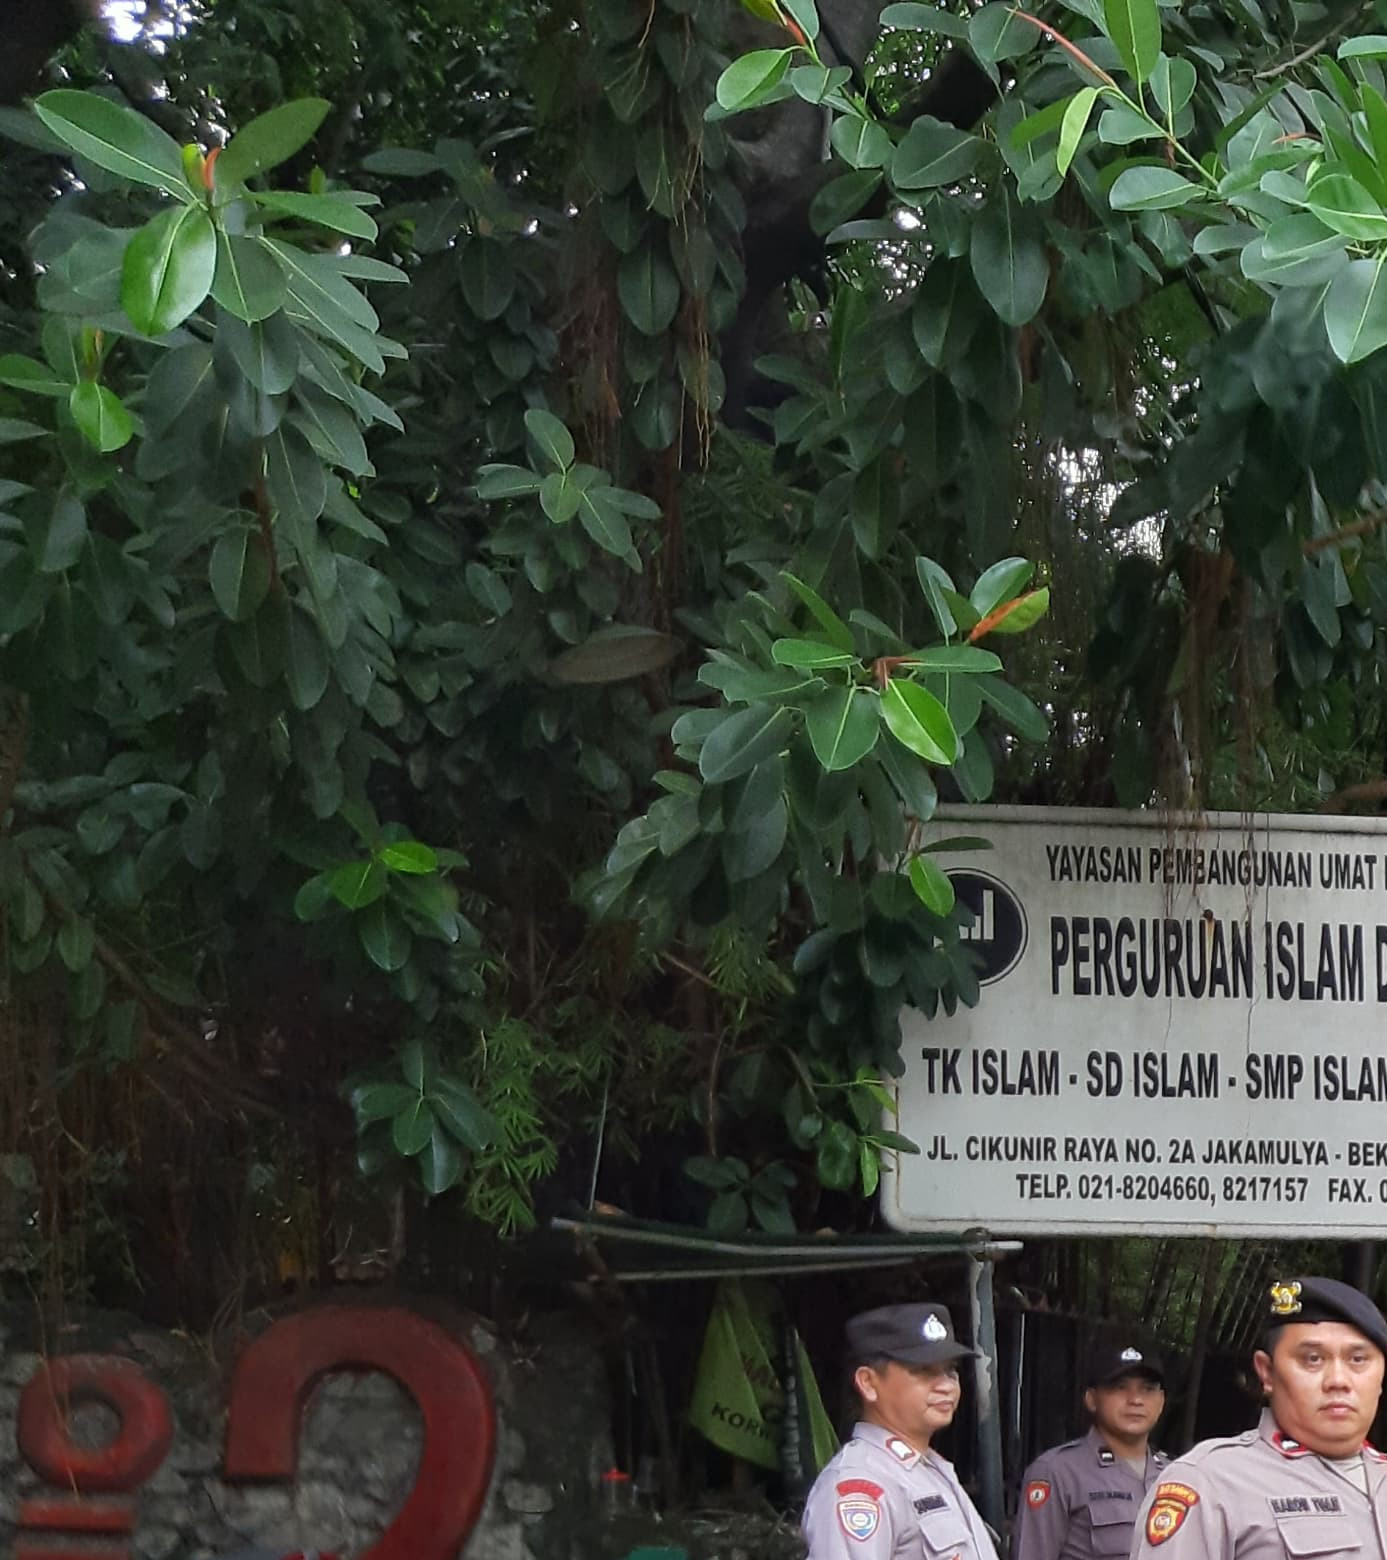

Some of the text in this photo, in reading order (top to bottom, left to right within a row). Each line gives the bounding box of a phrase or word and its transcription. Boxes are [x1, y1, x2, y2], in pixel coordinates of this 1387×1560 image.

[1045, 845, 1142, 884] YAYASAN
[1149, 848, 1312, 887] PEMBANGUNAN
[1319, 853, 1377, 890] UMAT
[1050, 916, 1254, 999] PERGURUAN
[1264, 921, 1364, 1001] ISLAM
[921, 1047, 962, 1094] TK
[972, 1048, 1060, 1096] ISLAM
[1086, 1050, 1123, 1097] SD
[1133, 1052, 1219, 1099] ISLAM
[1245, 1053, 1304, 1100] SMP
[927, 1135, 958, 1161] JL.
[965, 1135, 1057, 1162] CIKUNIR
[1064, 1137, 1119, 1162] RAYA
[1125, 1138, 1162, 1163] NO.
[1169, 1139, 1195, 1164] 2A
[1202, 1139, 1329, 1166] JAKAMULYA
[1015, 1173, 1071, 1199] TELP.
[1078, 1174, 1216, 1206] 021-8204660,
[1222, 1176, 1308, 1202] 8217157
[1328, 1178, 1372, 1203] FAX.
